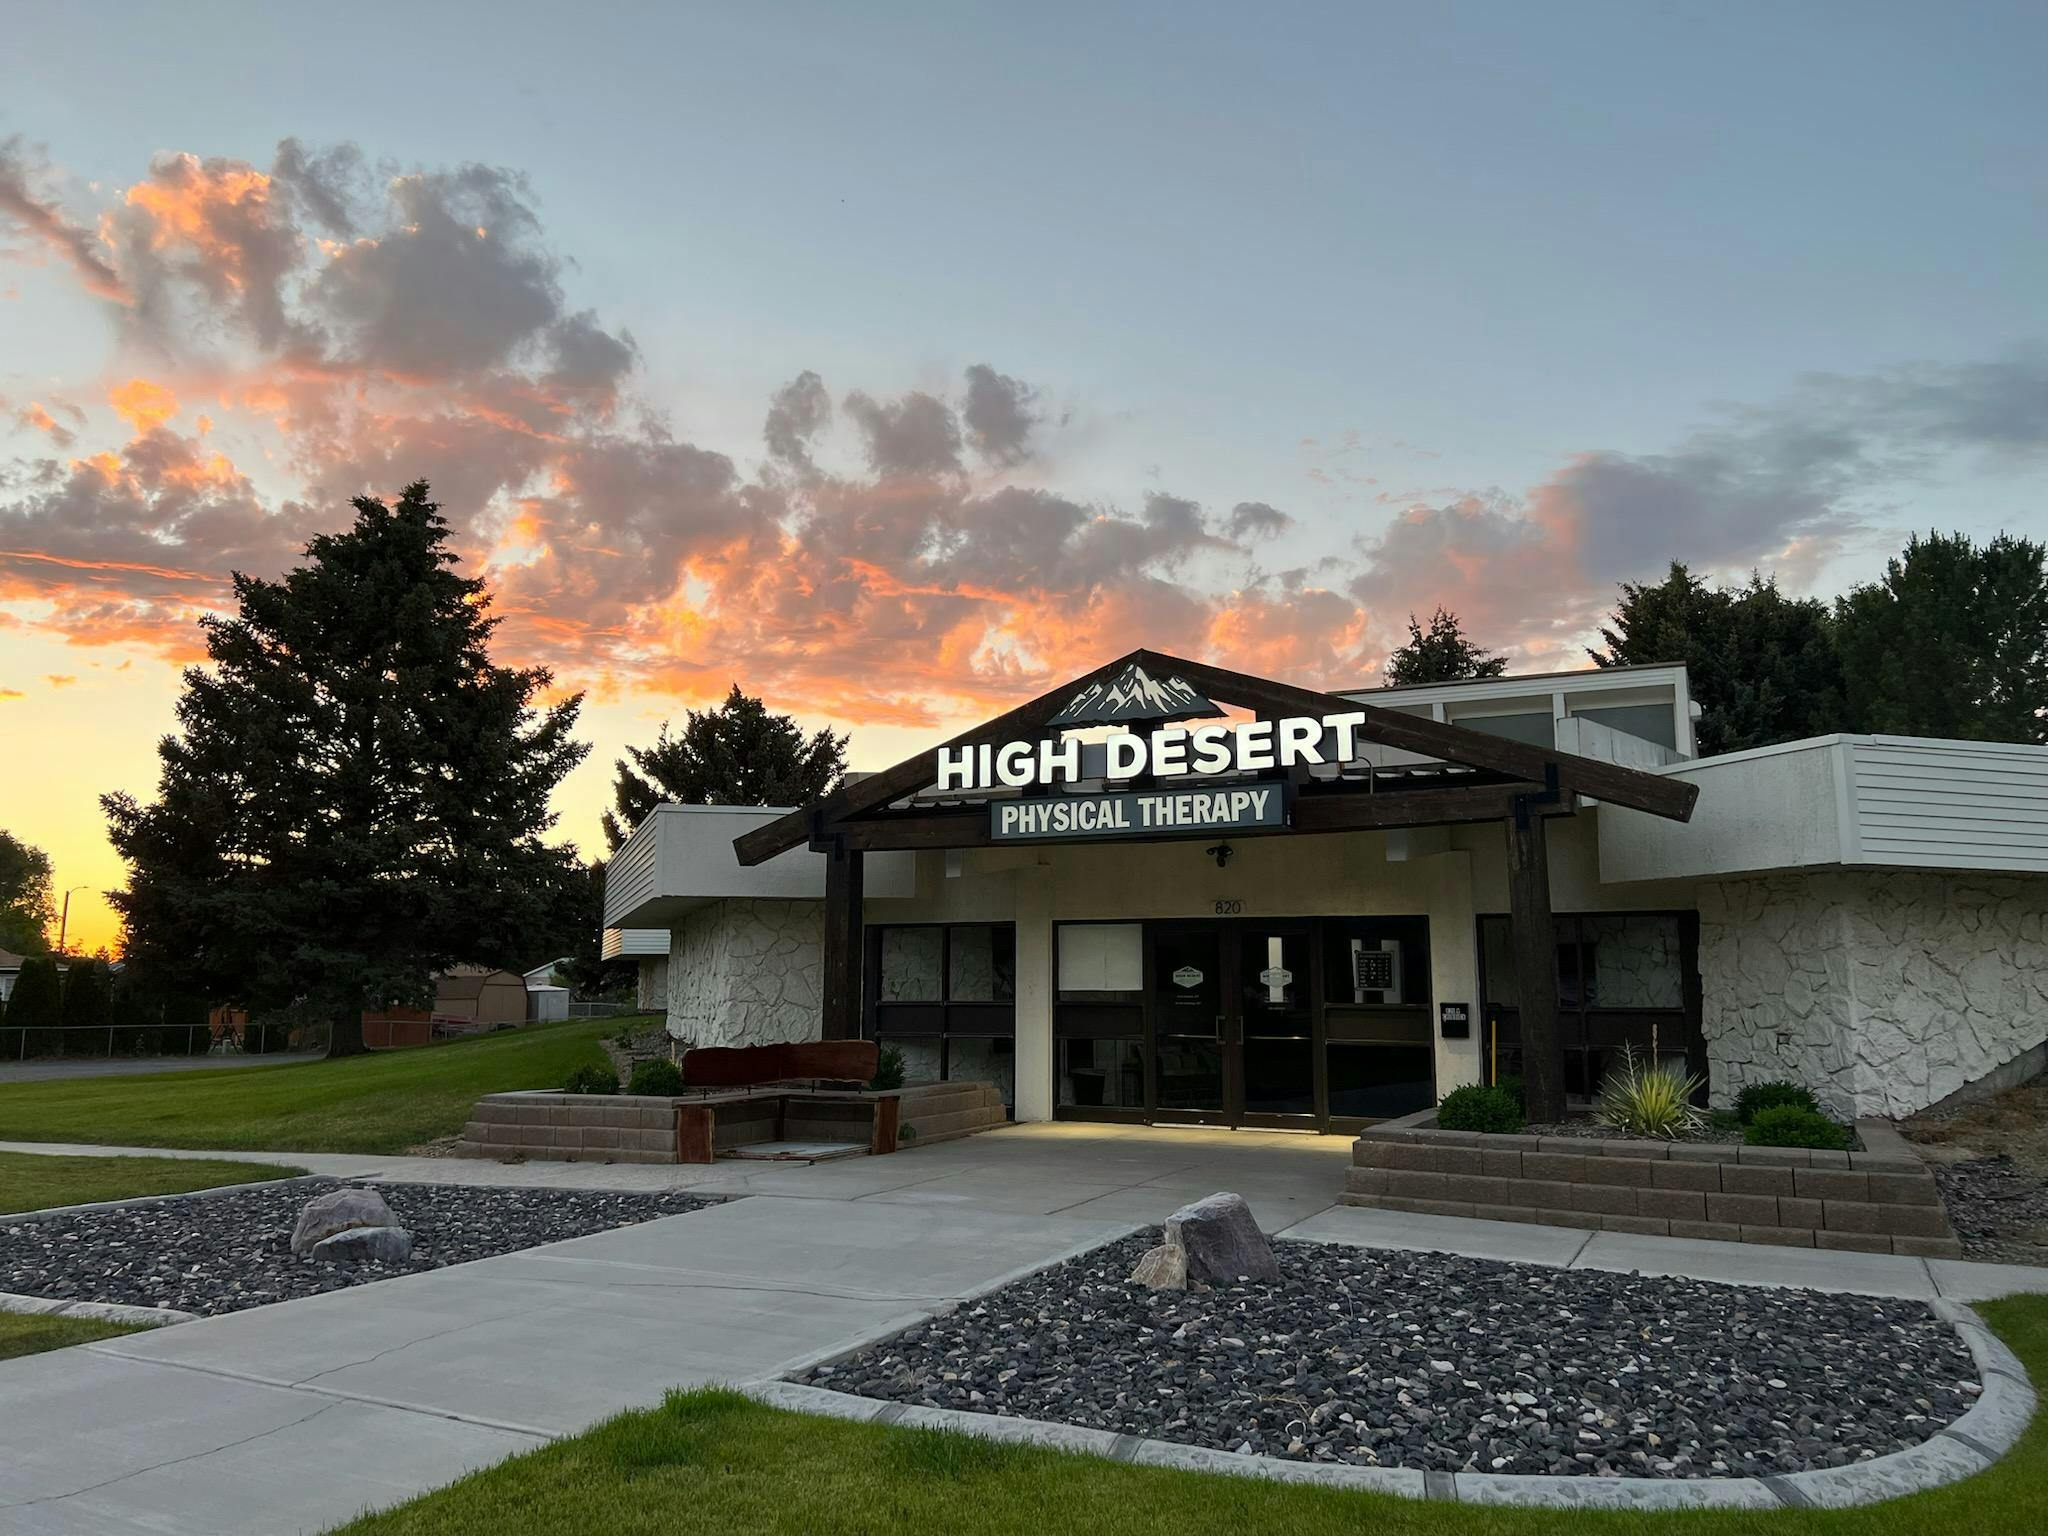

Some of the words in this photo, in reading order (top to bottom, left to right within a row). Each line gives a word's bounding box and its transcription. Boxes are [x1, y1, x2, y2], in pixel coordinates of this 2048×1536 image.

[937, 739, 1080, 790] HIGH
[1106, 711, 1366, 780] DESERT
[1001, 800, 1130, 835] PHYSICAL
[1138, 790, 1270, 826] THERAPY
[1215, 900, 1241, 914] 820
